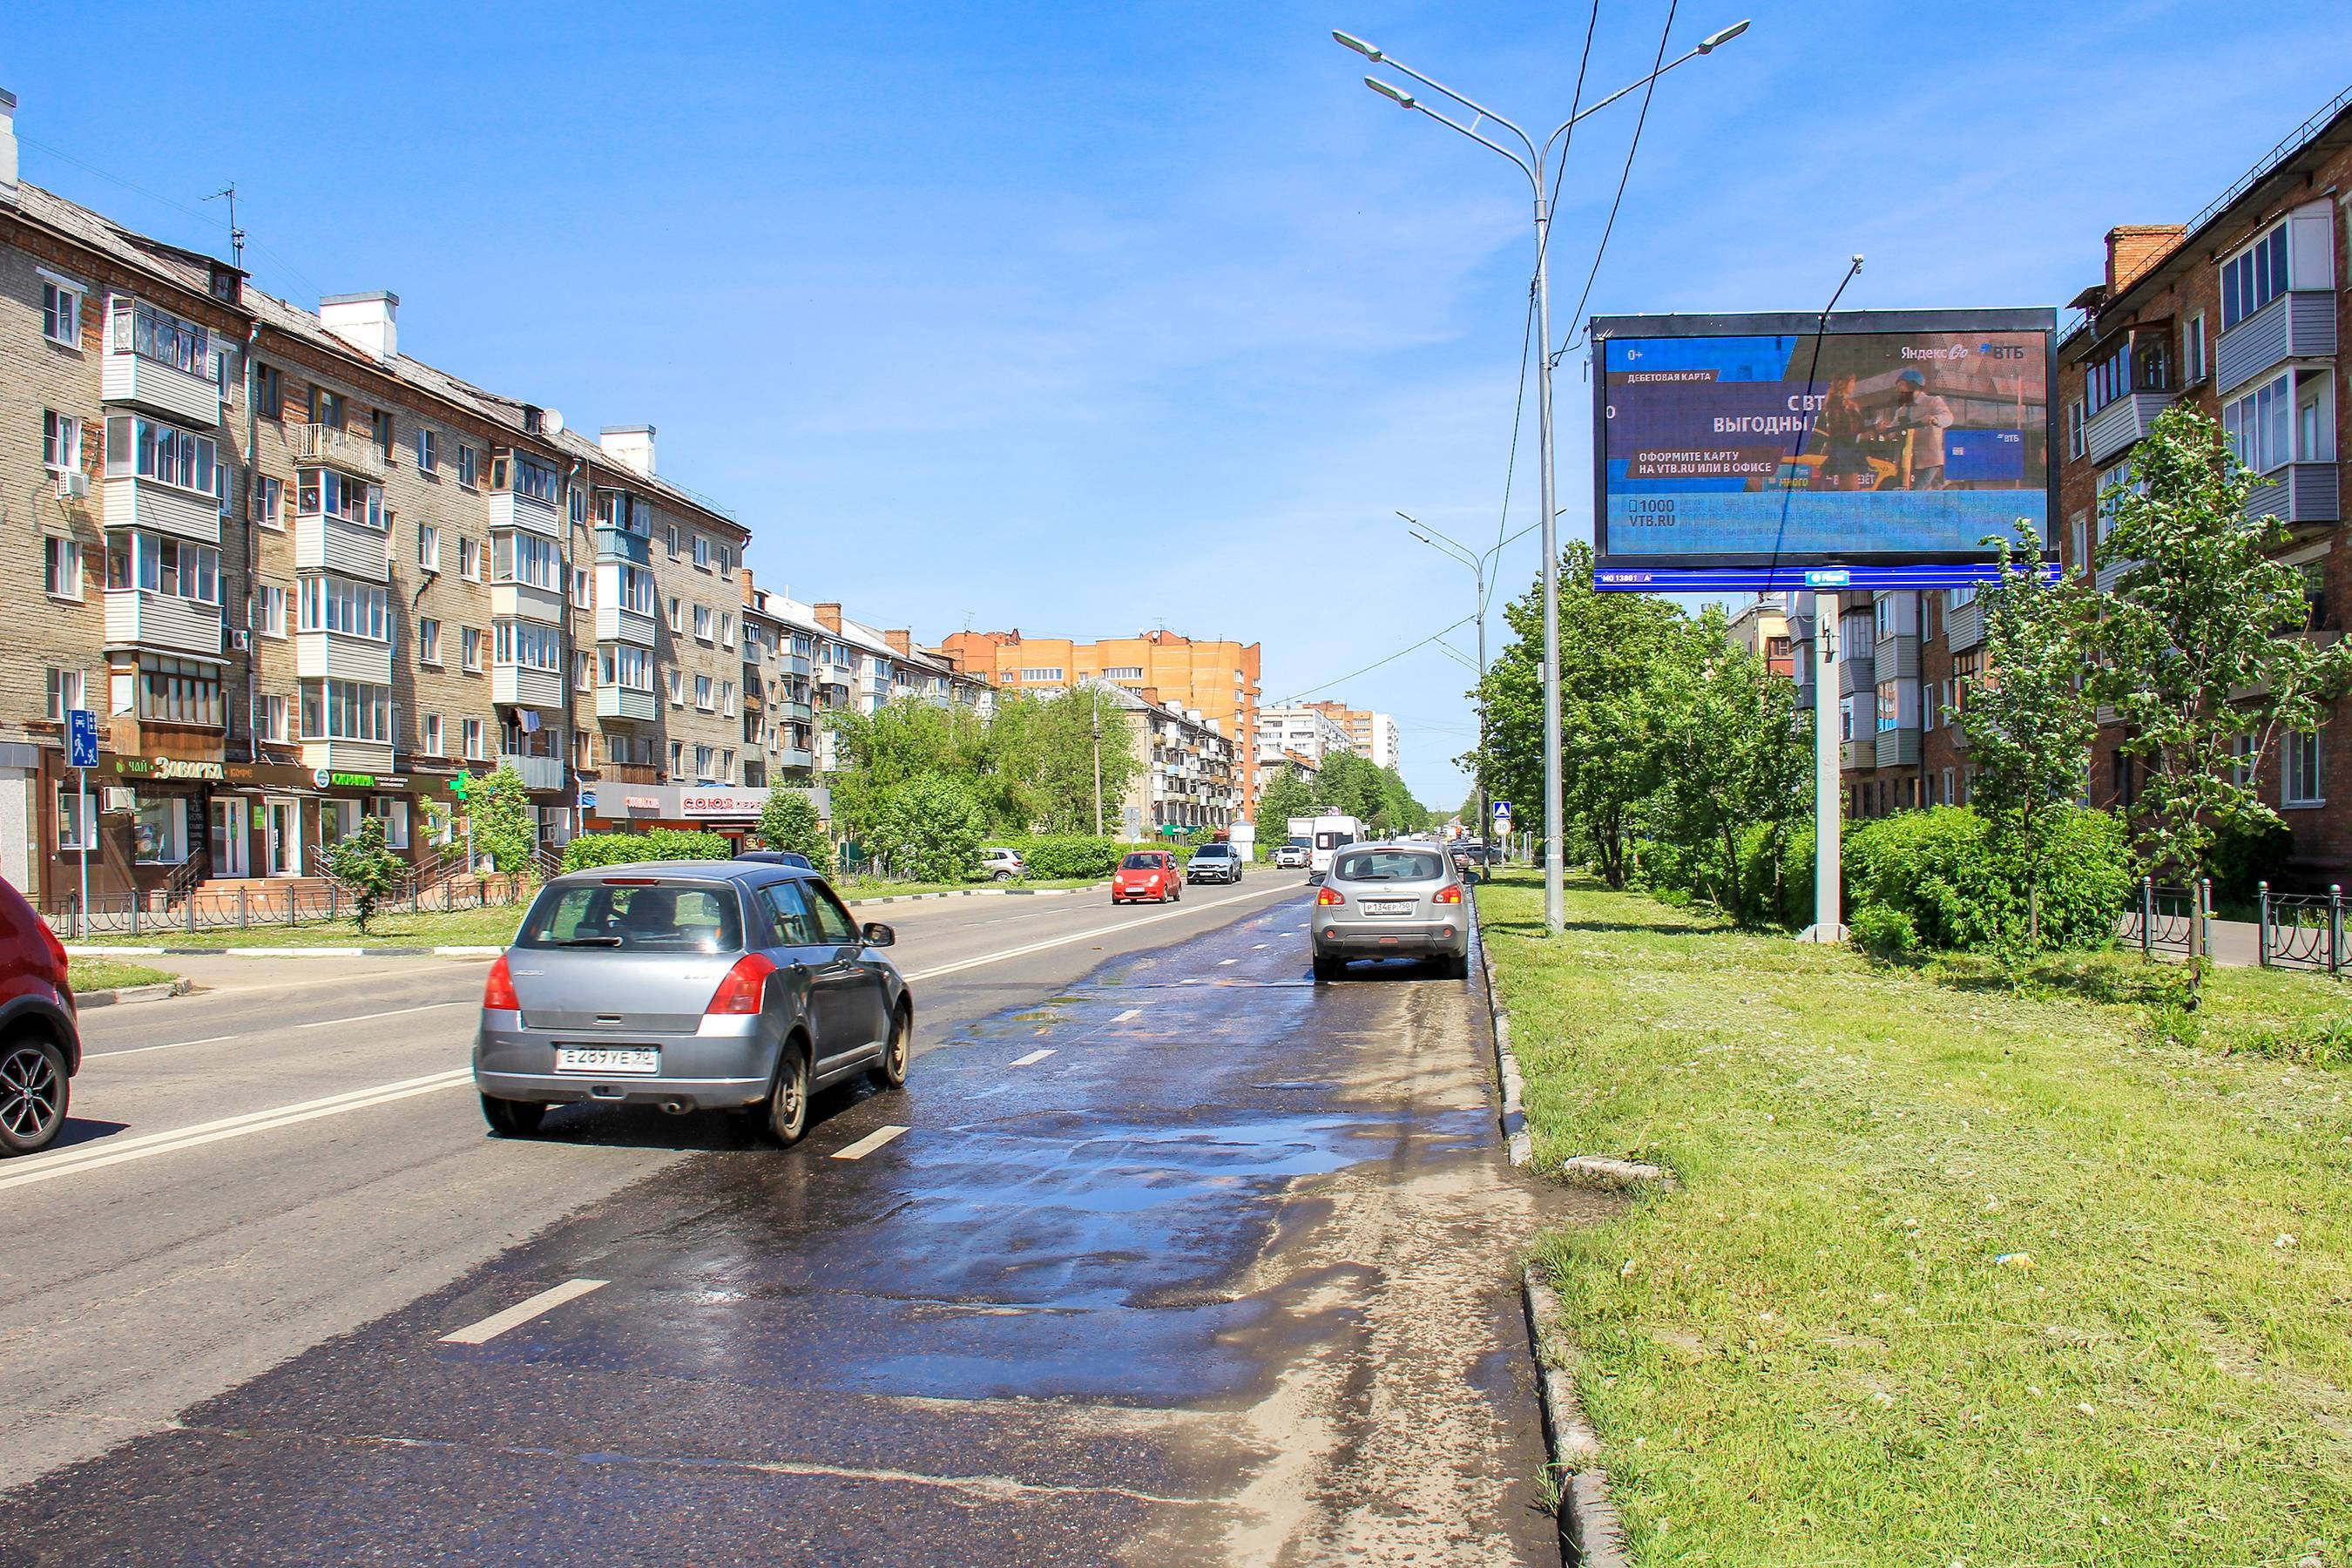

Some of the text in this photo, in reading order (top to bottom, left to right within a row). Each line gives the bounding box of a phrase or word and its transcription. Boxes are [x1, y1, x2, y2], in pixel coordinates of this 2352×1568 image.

[1627, 349, 1644, 362] 0+
[1901, 347, 1948, 360] Яндекс
[1992, 346, 2024, 360] ВТБ
[1627, 372, 1711, 384] ДЕБЕТОВАЯ КАРТА
[1787, 395, 1826, 411] С ВТ
[1639, 451, 1740, 463] ОФОРМИТЕ КАРТУ
[1639, 462, 1772, 474] НА VTB.RU ИЛИ В ОФИСЕ
[1640, 499, 1675, 512] 1000
[1629, 515, 1676, 527] VTB.RU
[128, 760, 147, 773] ЧАЙ
[683, 797, 733, 809] СОЮЗ
